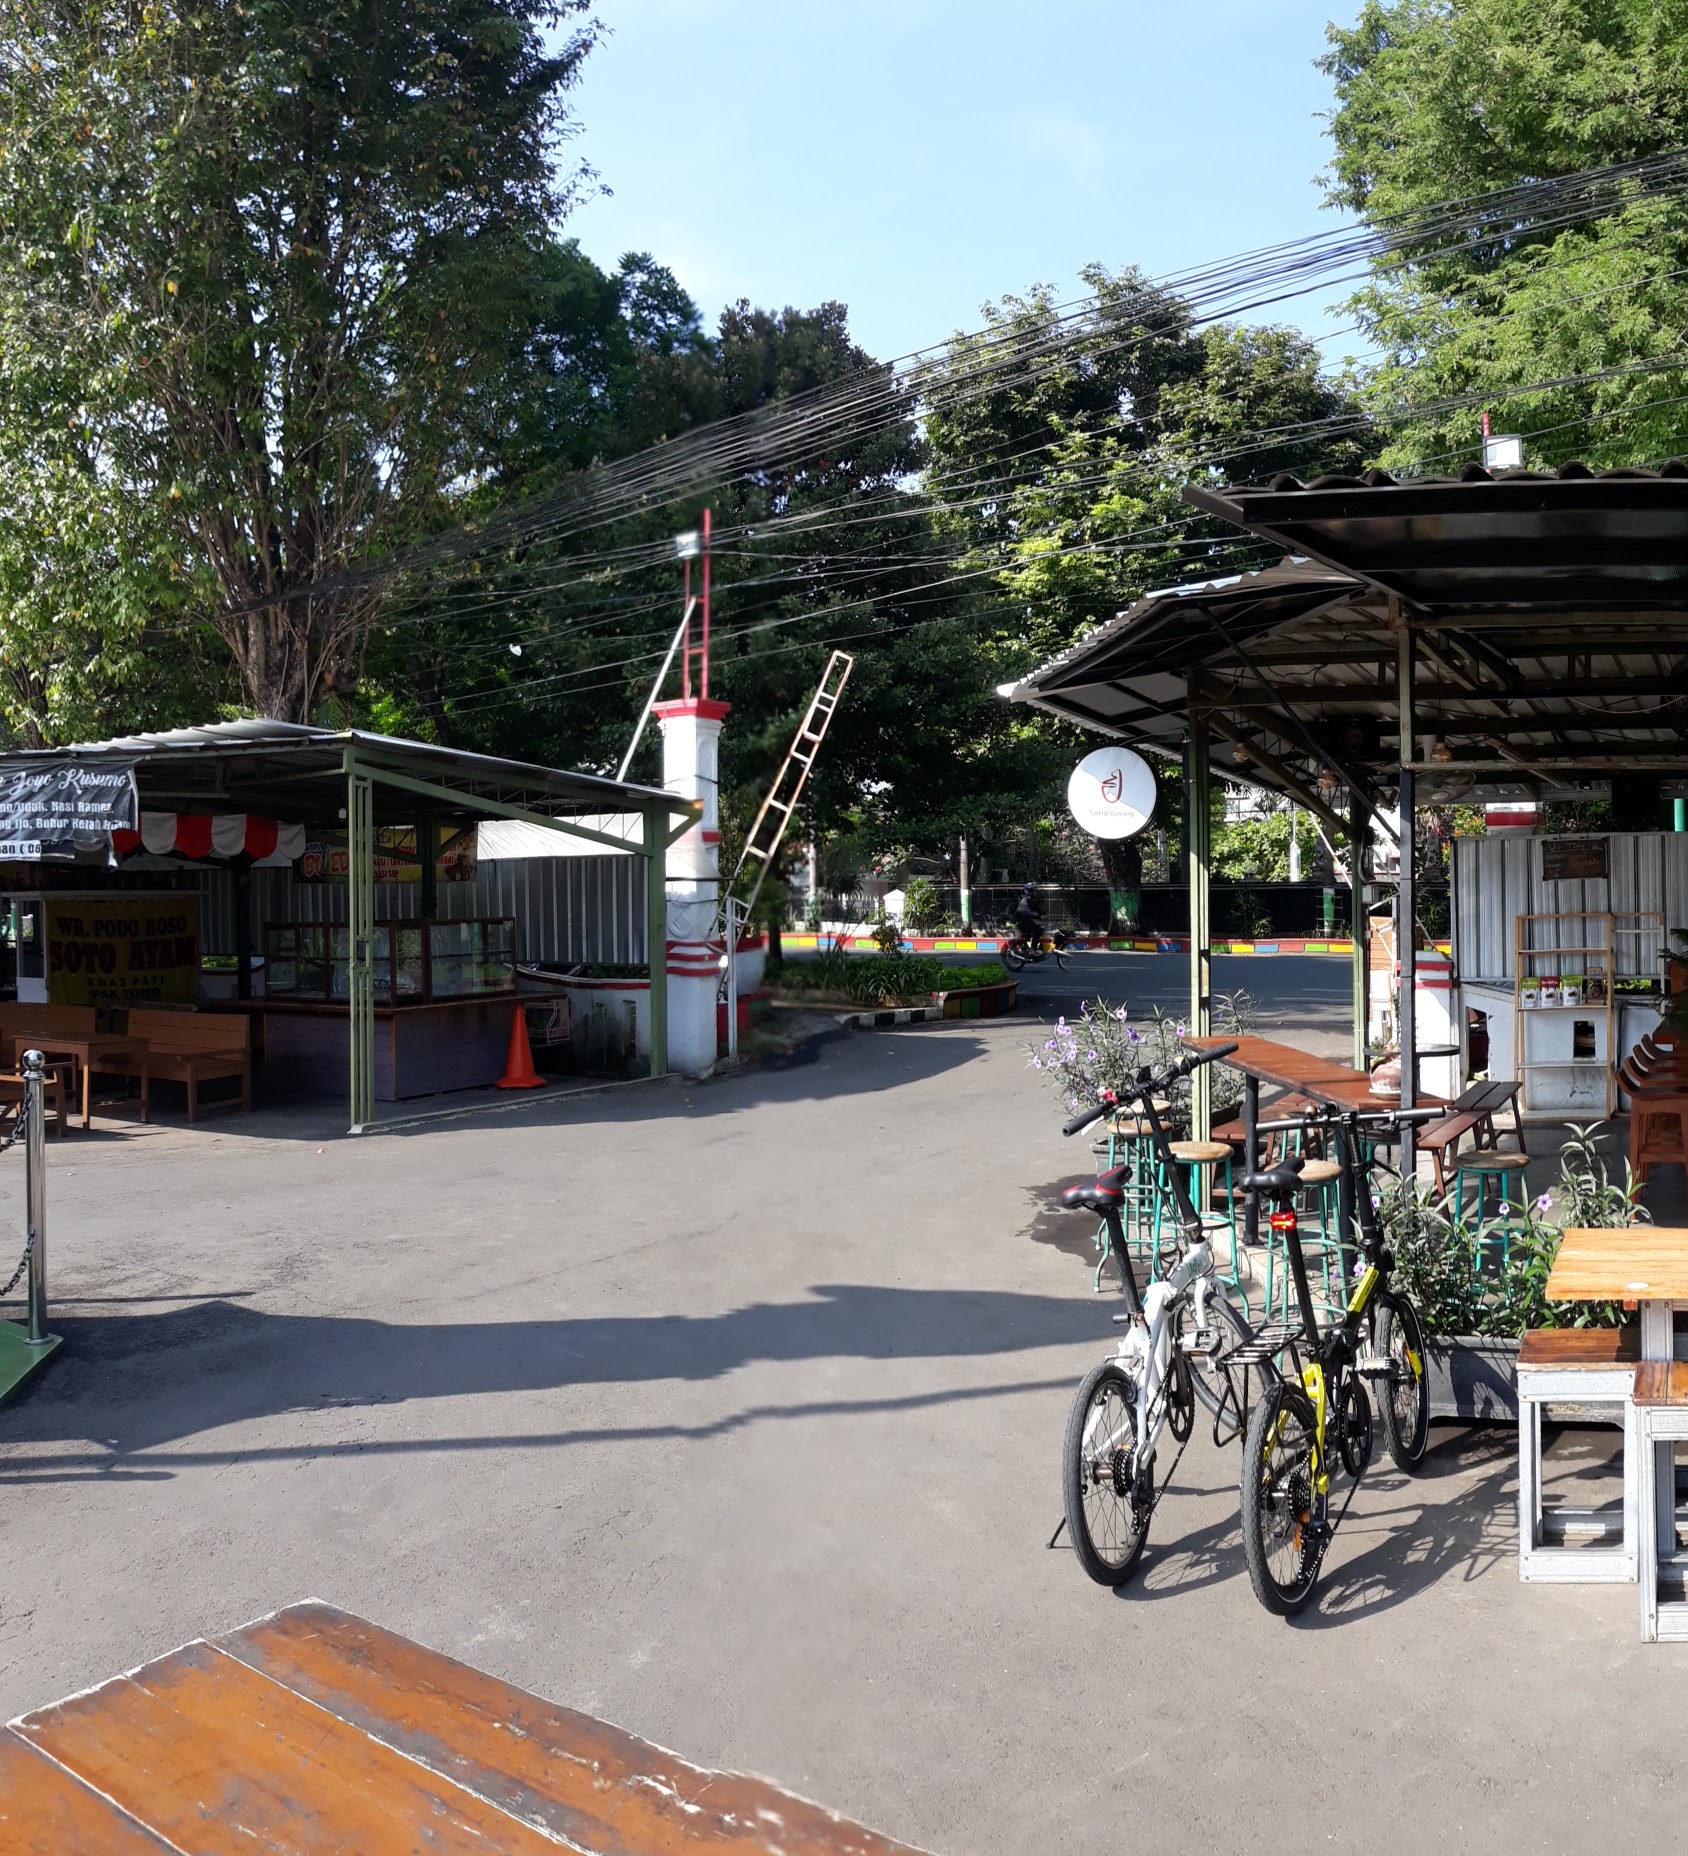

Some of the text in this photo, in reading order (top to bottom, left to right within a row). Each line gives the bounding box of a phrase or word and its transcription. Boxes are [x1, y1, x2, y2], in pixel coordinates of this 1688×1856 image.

[10, 771, 53, 796] Joyo
[58, 768, 128, 795] Kusumo
[52, 801, 75, 812] Nasi
[36, 818, 70, 829] Bubur
[94, 919, 139, 938] PODO
[145, 915, 187, 937] ROSO
[50, 940, 117, 974] SOTO
[88, 975, 165, 987] KHAS PATI
